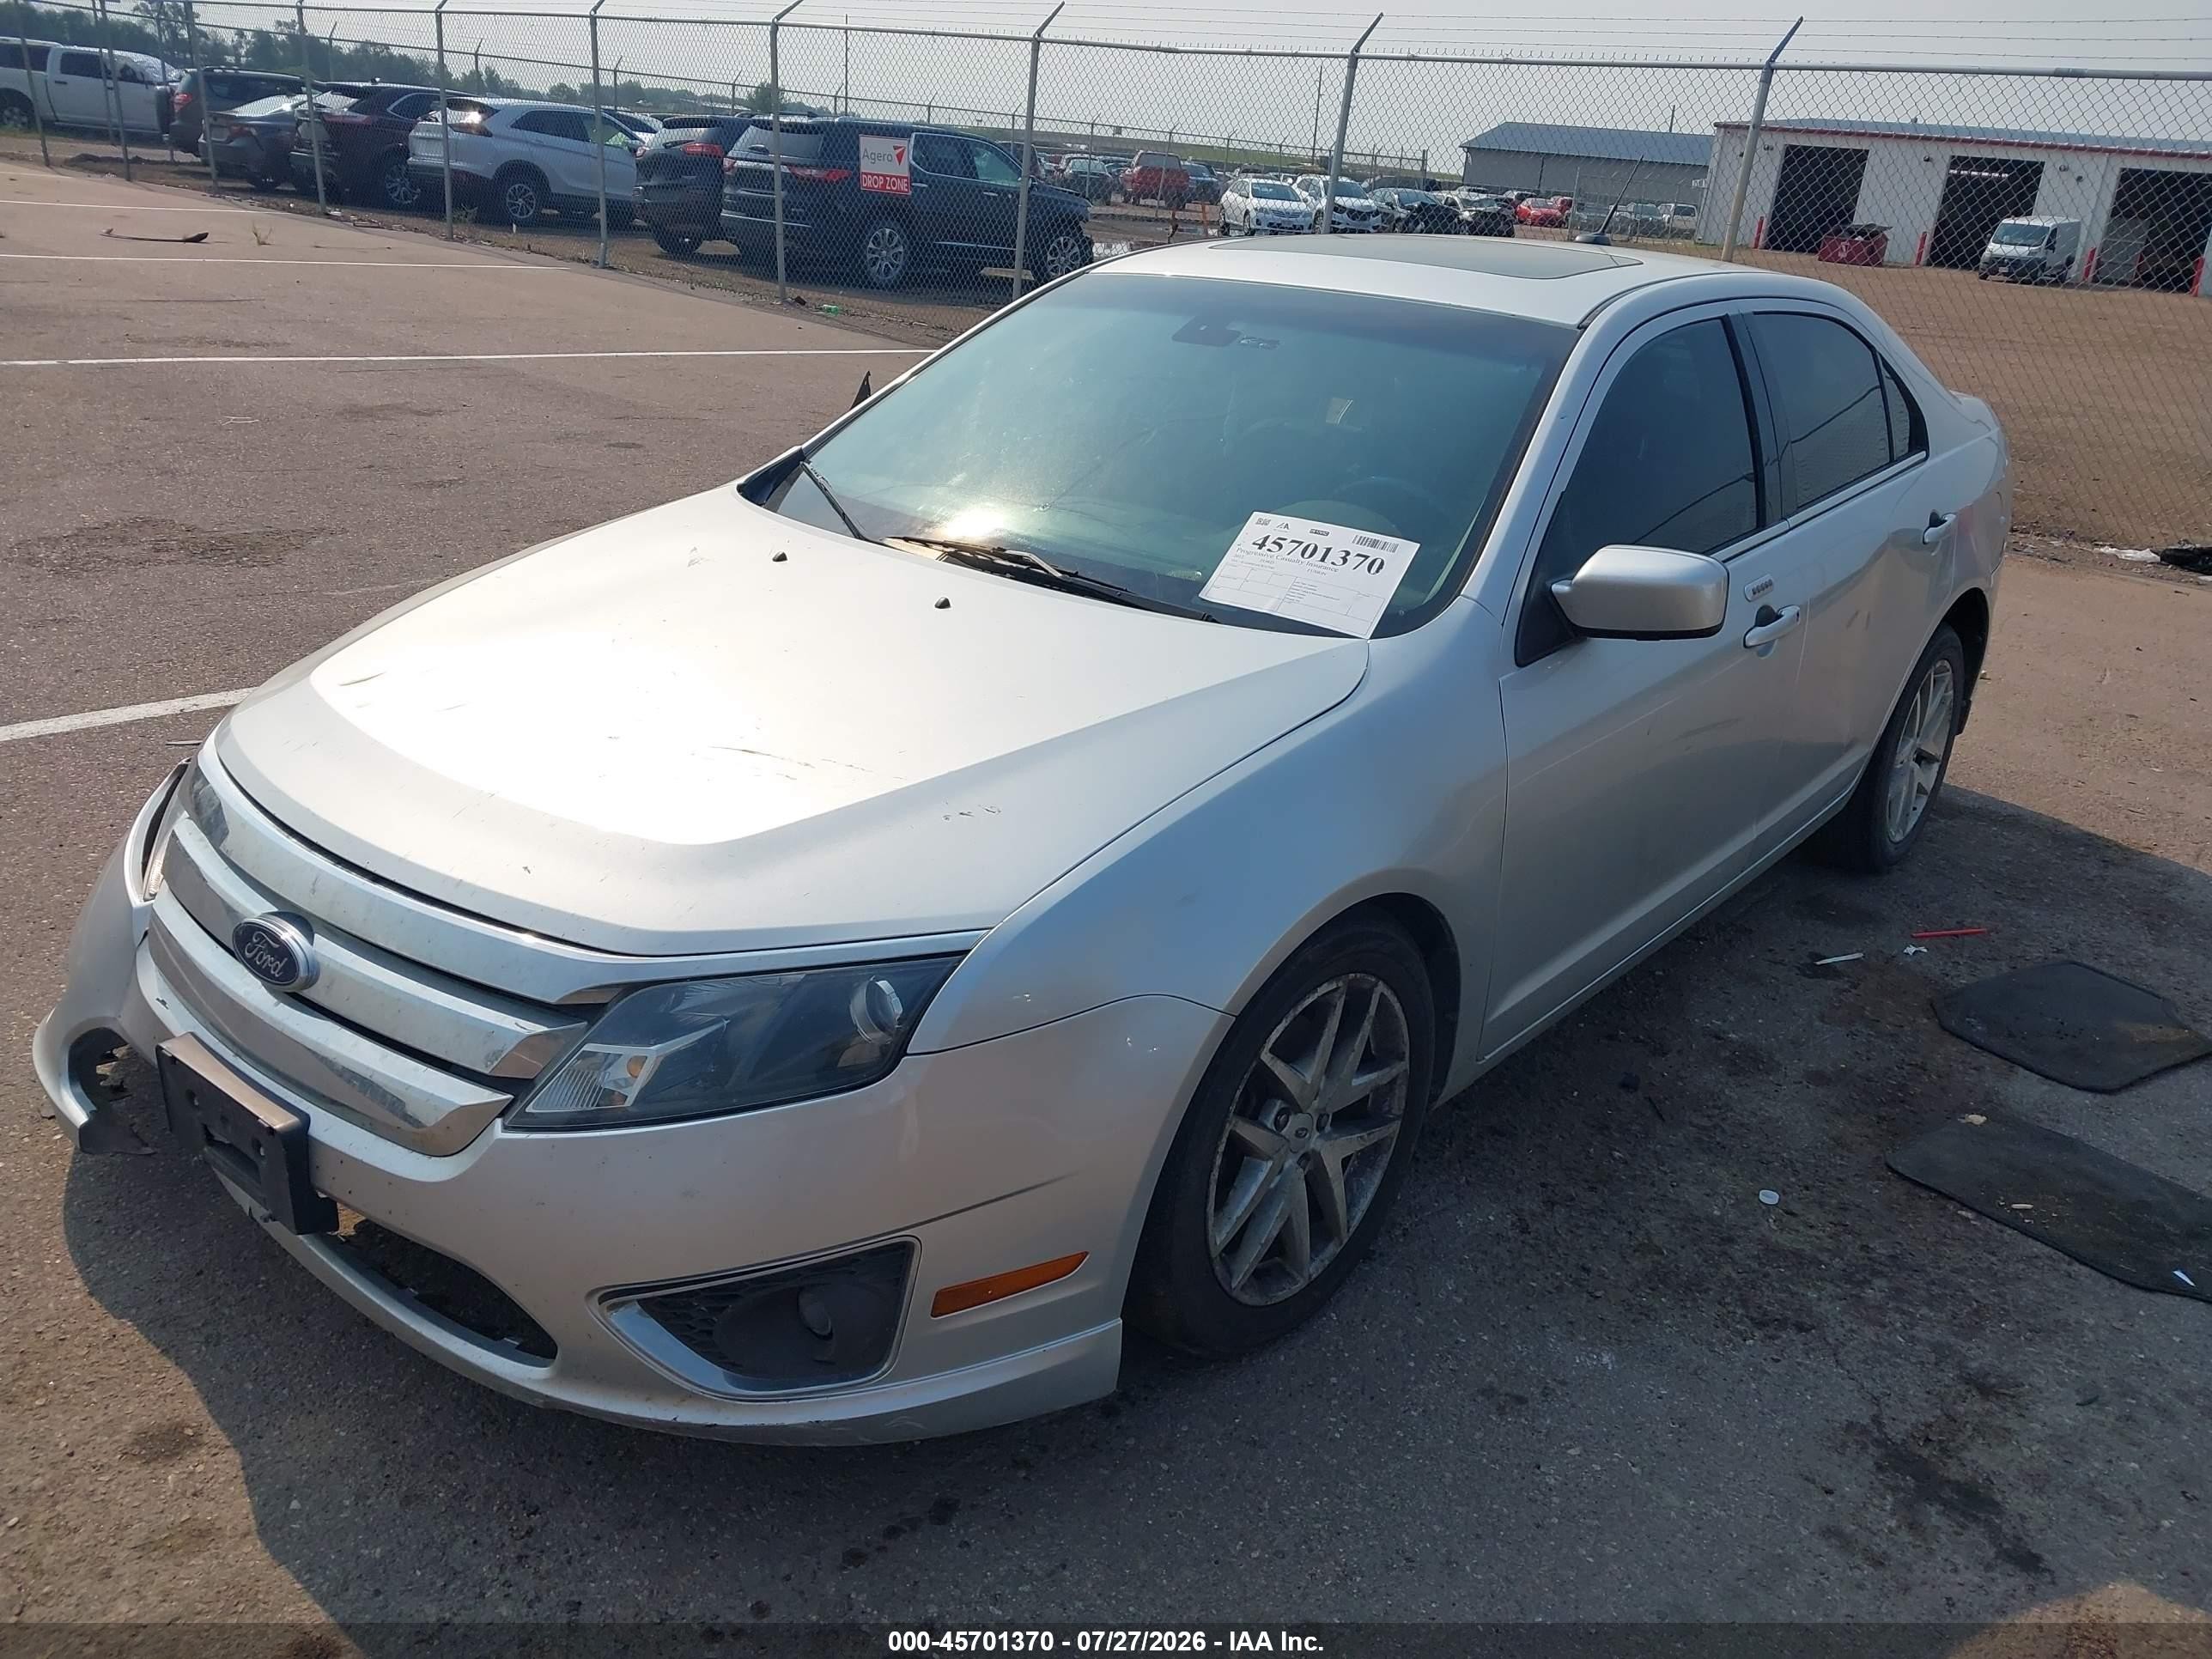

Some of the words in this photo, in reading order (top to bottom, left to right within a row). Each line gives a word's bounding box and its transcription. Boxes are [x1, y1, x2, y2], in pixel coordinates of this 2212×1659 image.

[862, 148, 892, 164] Agero
[862, 174, 884, 188] DROP
[886, 177, 908, 191] ZONE
[1237, 547, 1273, 560] Progressive
[1276, 554, 1304, 566] Casualty
[1306, 561, 1339, 573] Insurance
[1252, 534, 1385, 575] 45701370
[245, 931, 288, 977] Ford
